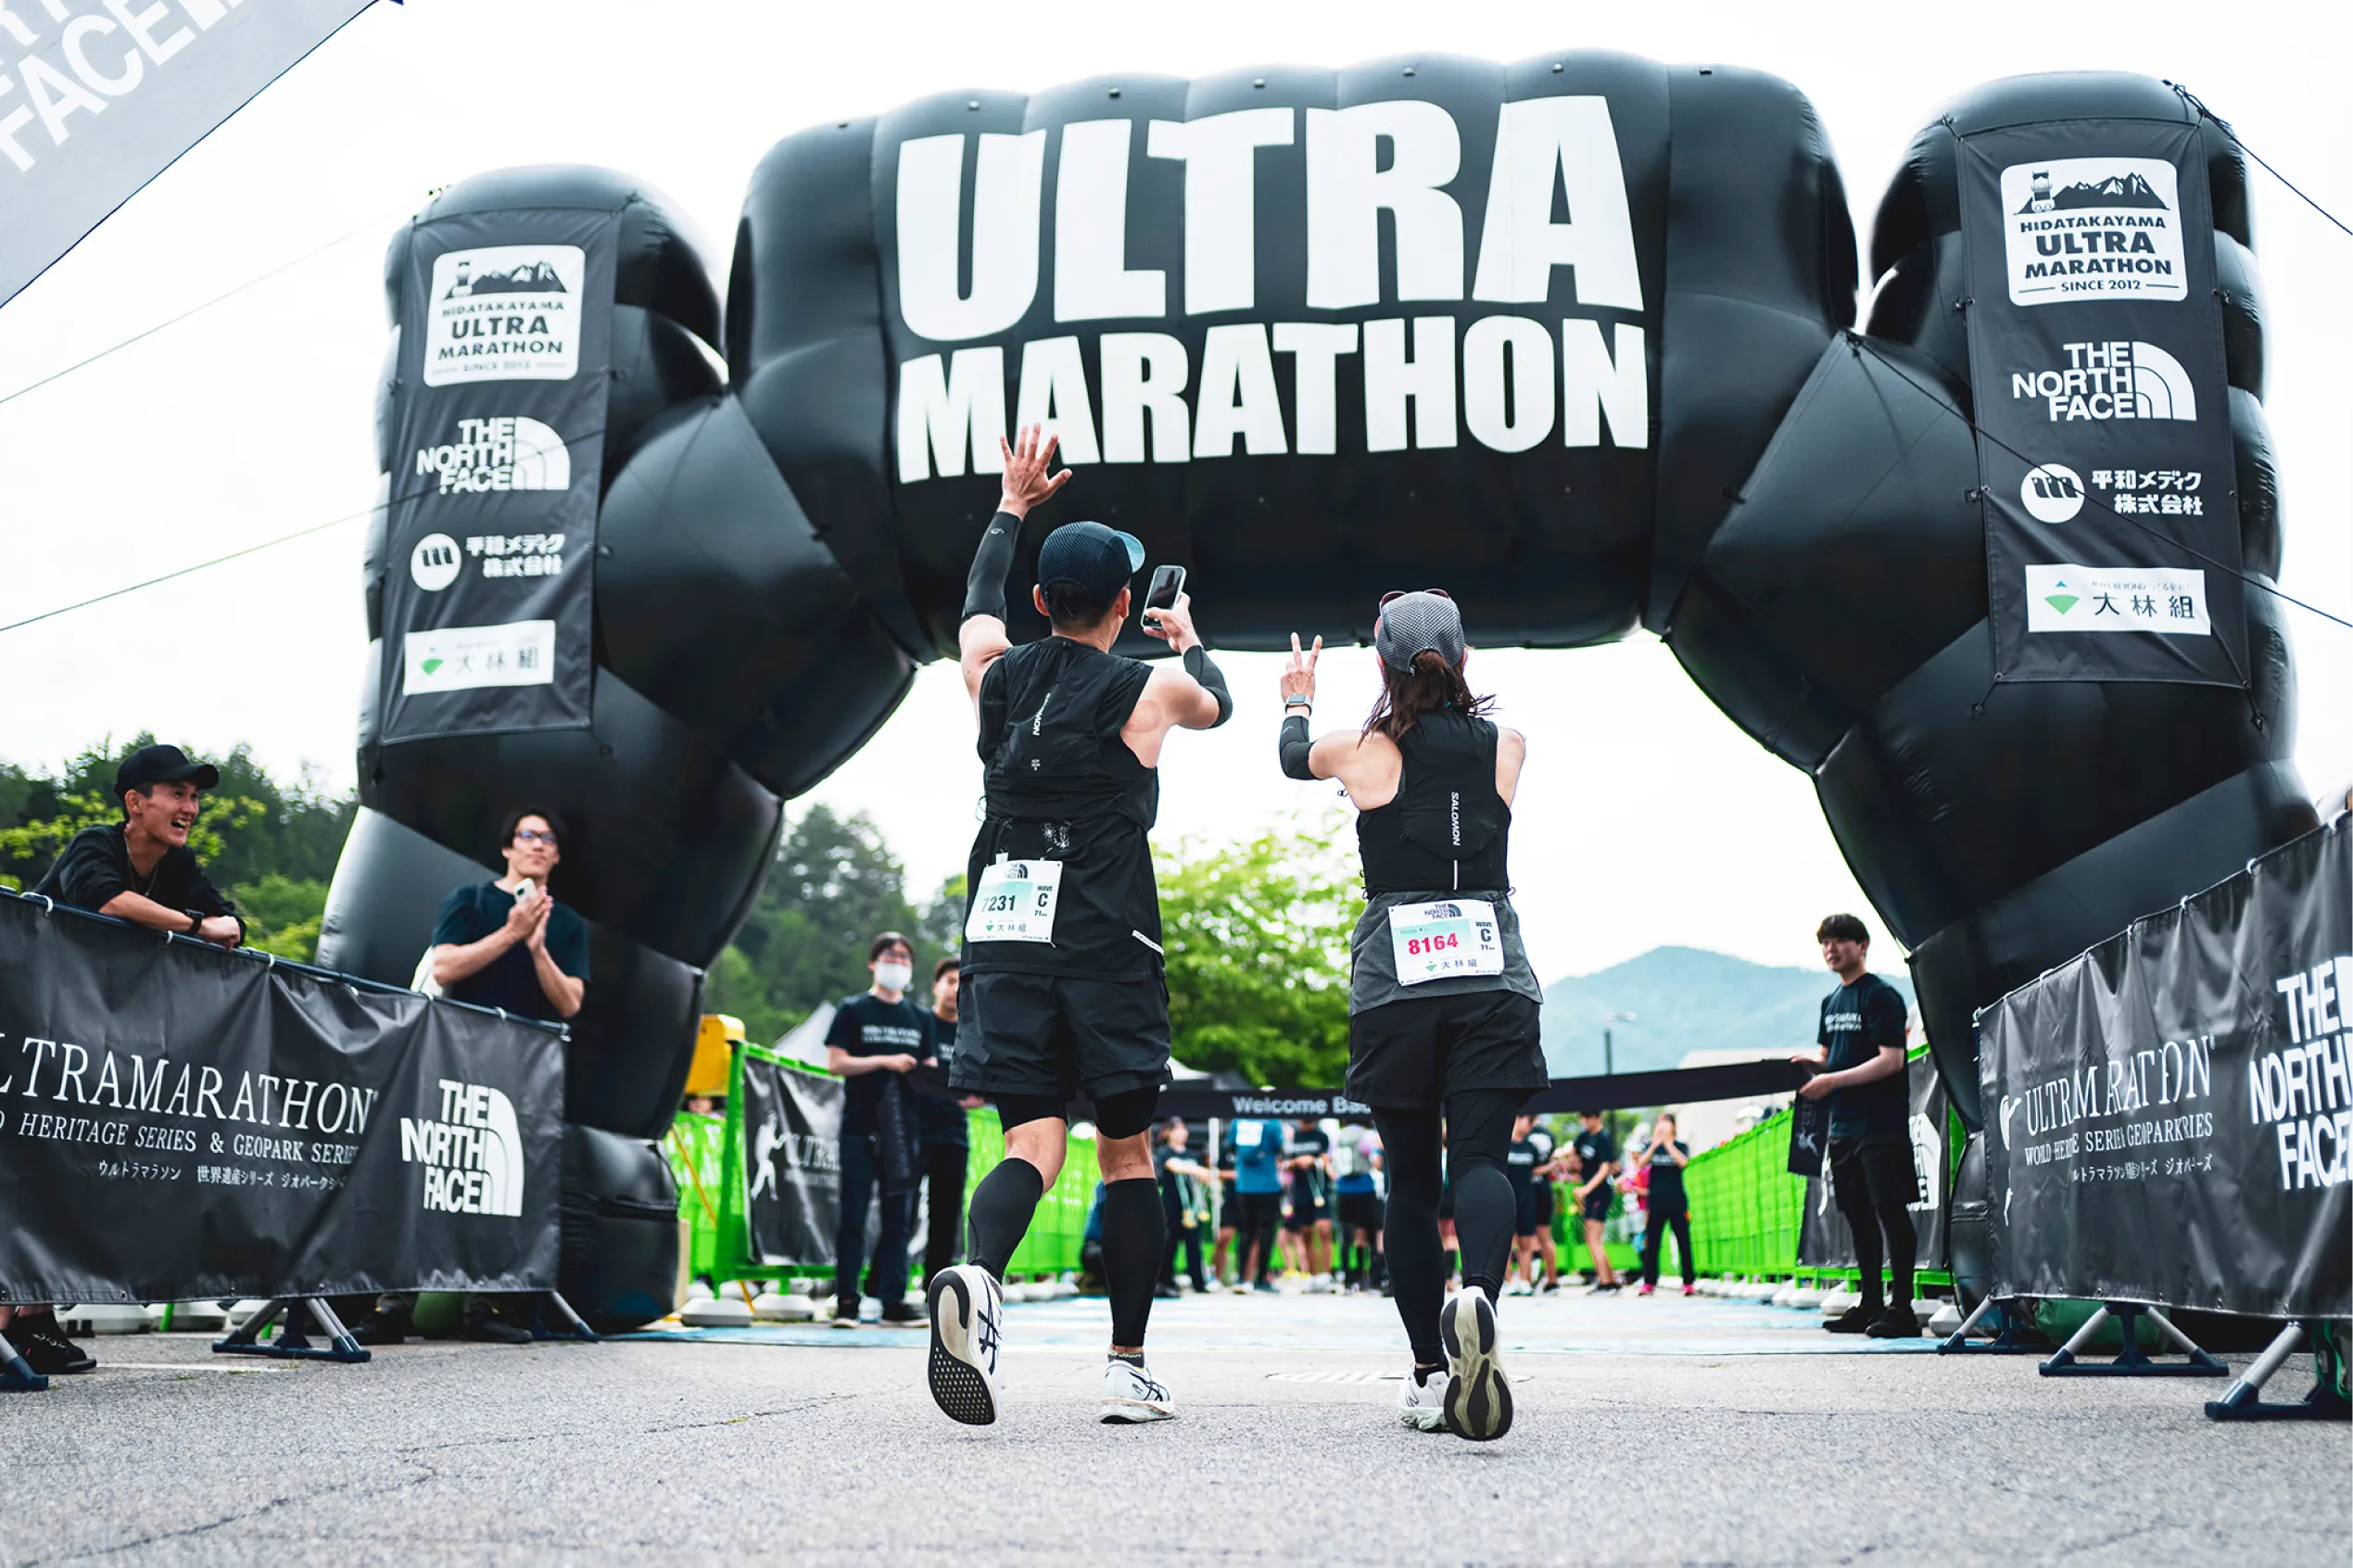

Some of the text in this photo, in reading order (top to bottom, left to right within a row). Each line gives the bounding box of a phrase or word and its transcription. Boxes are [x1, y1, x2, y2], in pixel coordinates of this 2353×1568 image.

[896, 95, 1644, 341] ULTRA
[2020, 215, 2167, 233] HIDATAKAYAMA
[2035, 231, 2156, 257] ULTRA
[2025, 258, 2172, 280] MARATHON
[2061, 279, 2141, 293] SINCE 2012
[442, 301, 564, 317] HIDATAKAYAMA
[451, 315, 550, 339] ULTRA
[437, 340, 563, 360] MARATHON
[2063, 341, 2132, 369] THE
[2012, 366, 2134, 398] NORTH
[900, 315, 1649, 484] MARATHON
[2049, 391, 2135, 422] FACE
[458, 417, 515, 444] THE
[416, 441, 514, 475] NORTH
[438, 465, 512, 495] FACE
[2091, 470, 2203, 491] 平和メディク
[2114, 493, 2204, 515] 株式会社
[2093, 591, 2195, 619] 大林組
[1450, 790, 1461, 847] SALOMON
[981, 894, 1017, 913] 7231
[1038, 892, 1048, 908] C
[1408, 932, 1459, 955] 8164
[1480, 929, 1491, 942] C
[2276, 959, 2341, 1043] THE
[2248, 1033, 2352, 1124] NORTH
[438, 1078, 490, 1129] THE
[1232, 1095, 1328, 1115] Welcome
[18, 1113, 128, 1146] HERITAGE
[134, 1125, 196, 1153] SERIES
[210, 1131, 225, 1155] &
[234, 1132, 304, 1162] GEOPARK
[400, 1118, 486, 1171] NORTH
[2277, 1111, 2351, 1191] FACE
[424, 1166, 483, 1213] FACE
